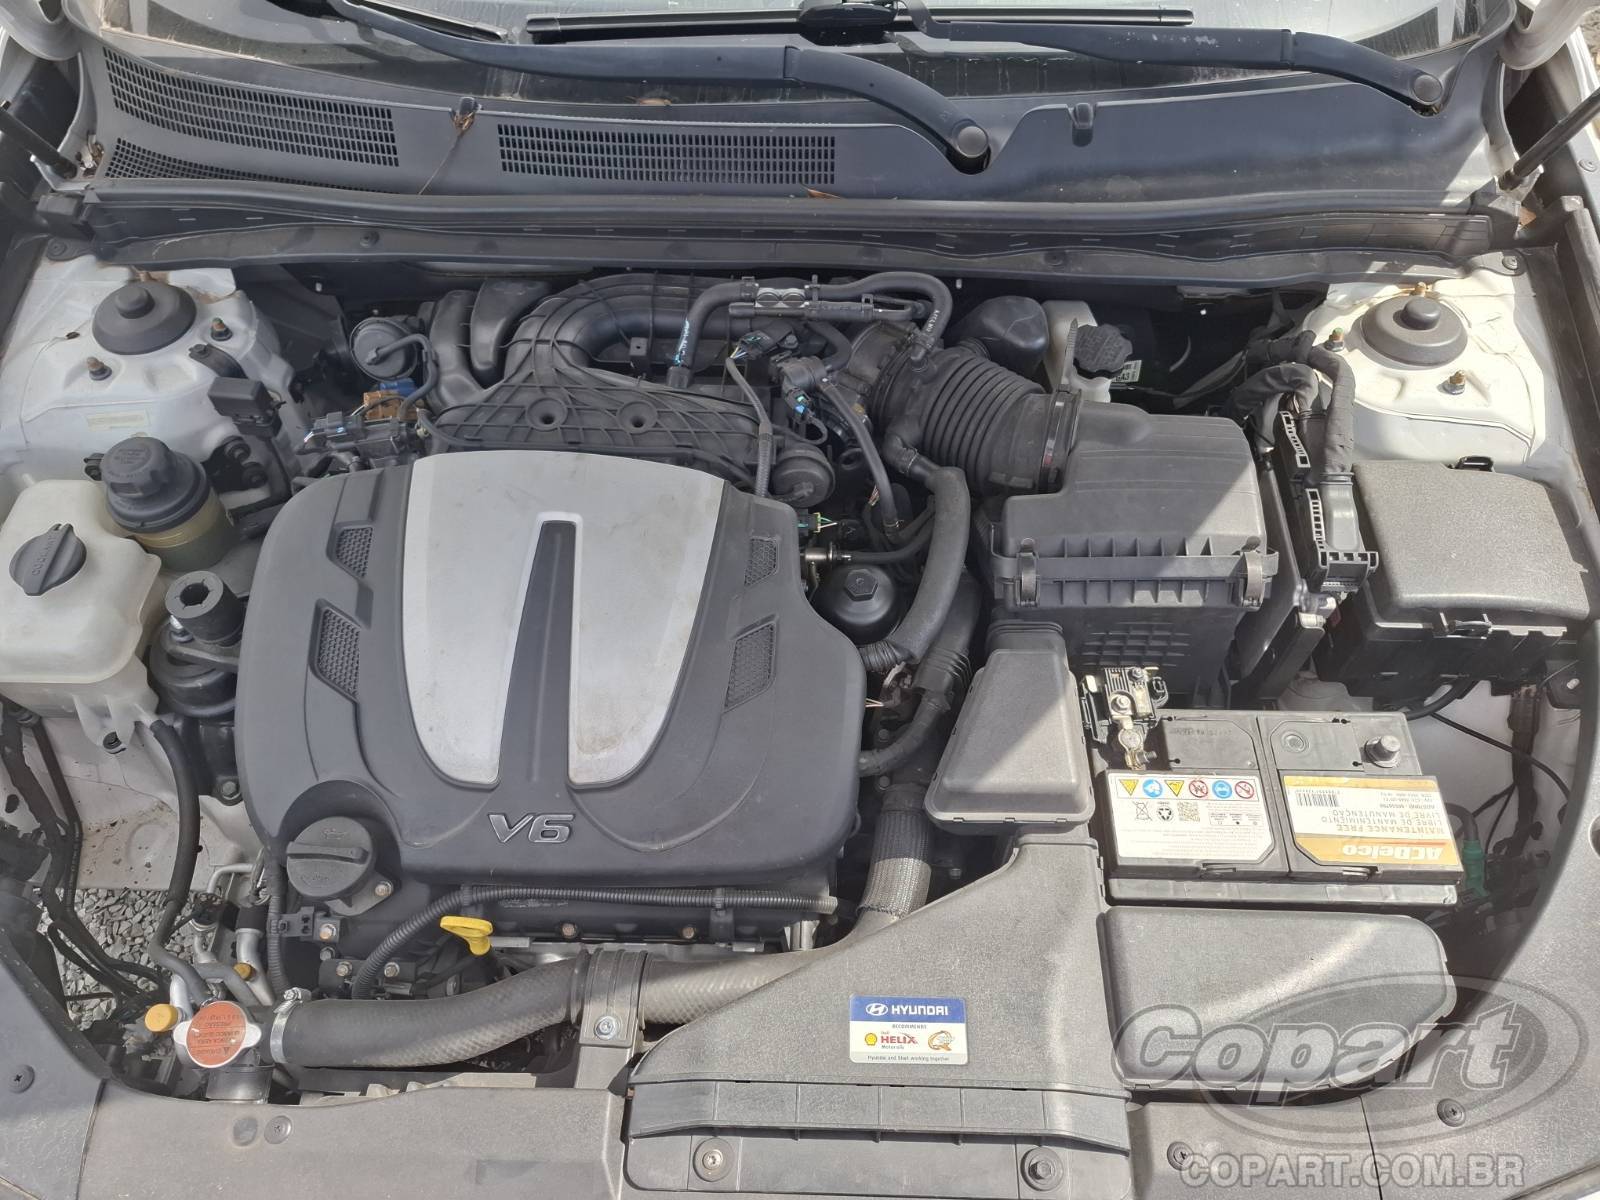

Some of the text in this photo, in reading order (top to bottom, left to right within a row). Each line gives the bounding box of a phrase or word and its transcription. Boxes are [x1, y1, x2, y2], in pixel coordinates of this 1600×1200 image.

[488, 813, 575, 843] V6
[1335, 824, 1444, 834] MAINTENANCE FREE
[1343, 845, 1444, 860] ACDelco
[891, 1005, 948, 1015] HYUNDAI
[880, 1035, 917, 1044] HELIX
